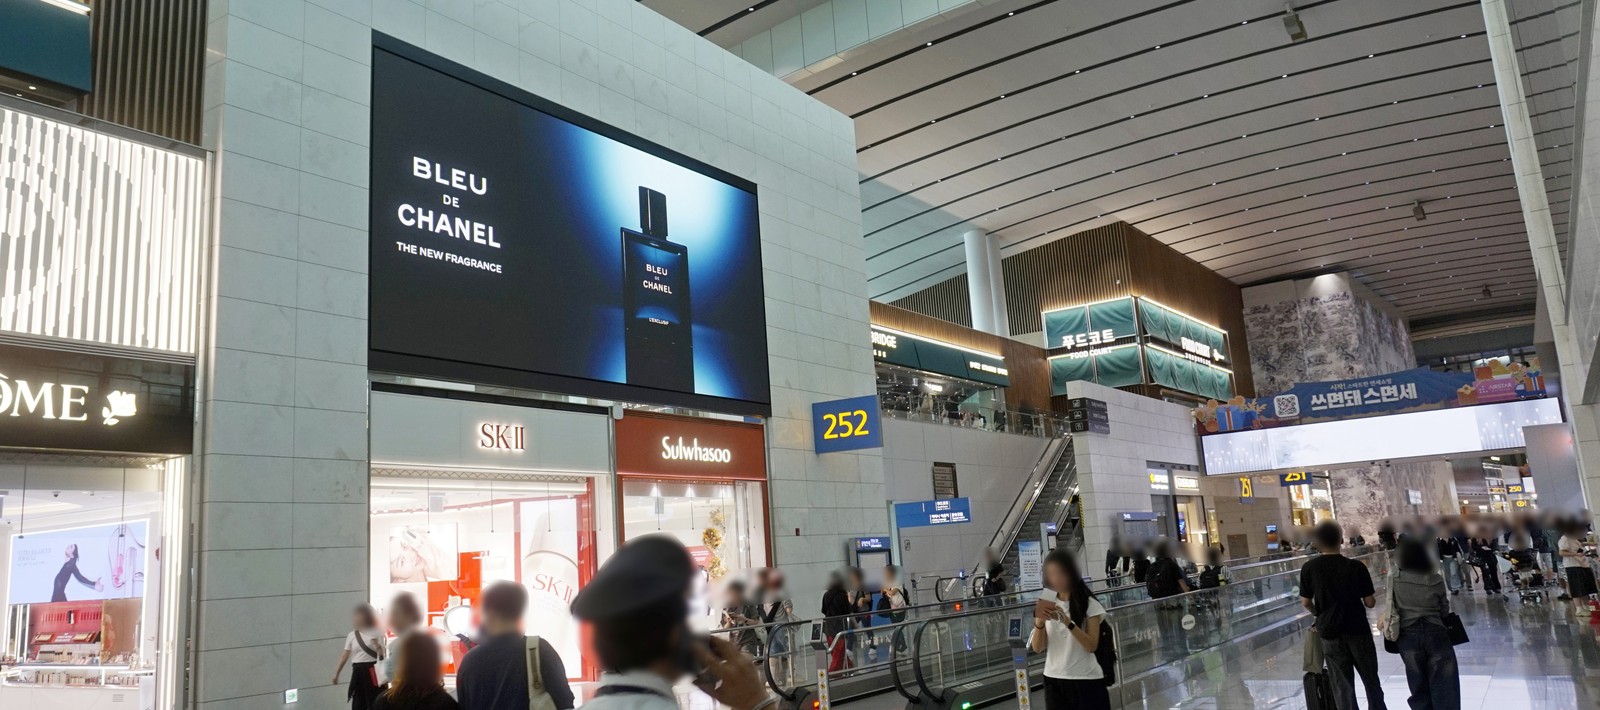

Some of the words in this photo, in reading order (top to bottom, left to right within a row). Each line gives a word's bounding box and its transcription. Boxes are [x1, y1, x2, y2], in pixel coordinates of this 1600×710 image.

[412, 156, 486, 194] BLEU
[442, 194, 459, 207] DE
[397, 203, 501, 248] CHANEL
[396, 241, 417, 254] THE
[419, 245, 442, 259] NEW
[445, 252, 502, 274] FRAGRANCE
[645, 263, 667, 275] BLEU
[642, 279, 672, 294] CHANEL
[1062, 328, 1115, 348] 푸드코트
[1069, 350, 1088, 359] FOOD
[1089, 347, 1111, 356] COURT
[1310, 389, 1362, 410] 쓰면돼
[1363, 382, 1417, 404] 스면세
[480, 422, 525, 450] SK-II
[822, 409, 869, 439] 252
[661, 435, 731, 463] Sulwhasoo
[1284, 471, 1306, 481] 251
